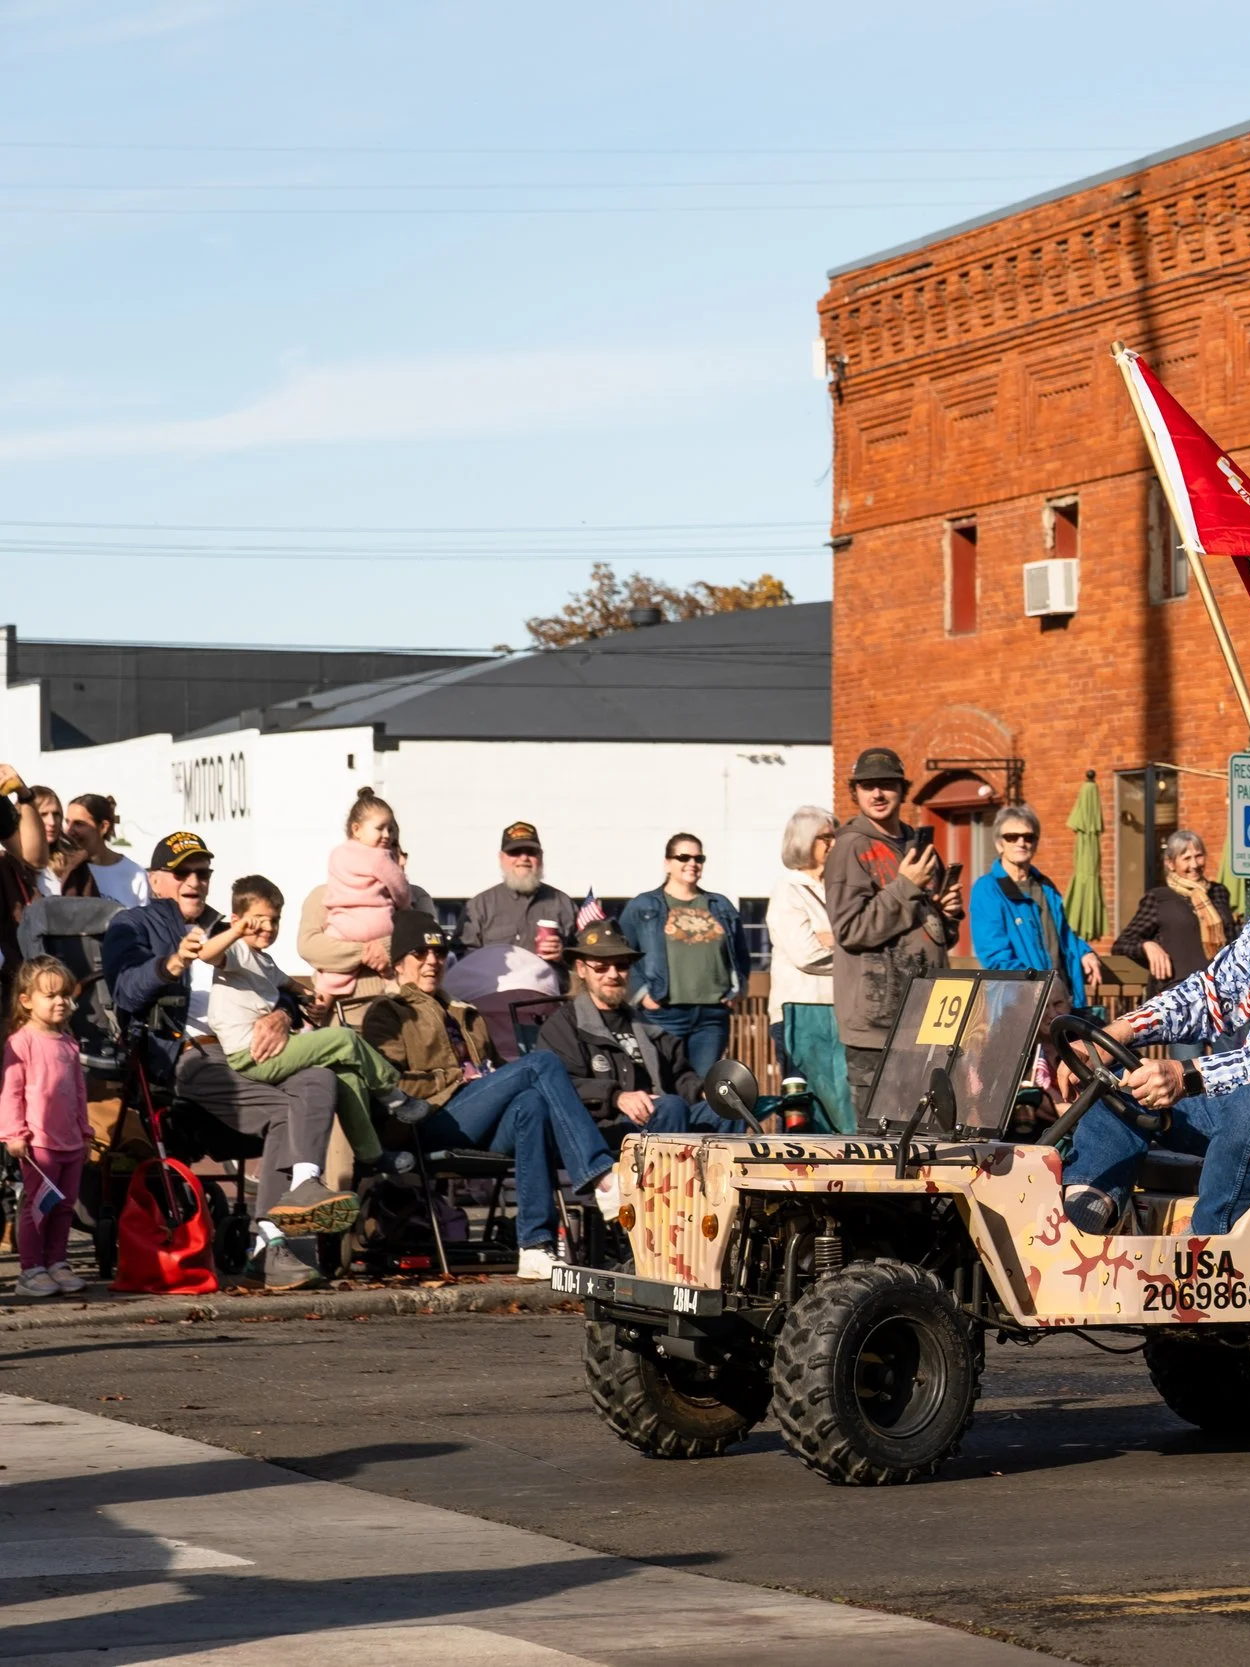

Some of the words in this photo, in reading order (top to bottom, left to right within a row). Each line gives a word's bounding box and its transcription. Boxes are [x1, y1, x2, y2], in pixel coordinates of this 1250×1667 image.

[182, 754, 226, 825] MOTOR
[229, 751, 251, 818] CO.
[423, 932, 443, 945] CAT
[932, 995, 962, 1029] 19
[749, 1142, 817, 1159] U.S.
[1174, 1250, 1235, 1280] USA
[551, 1267, 581, 1295] NO.10-1
